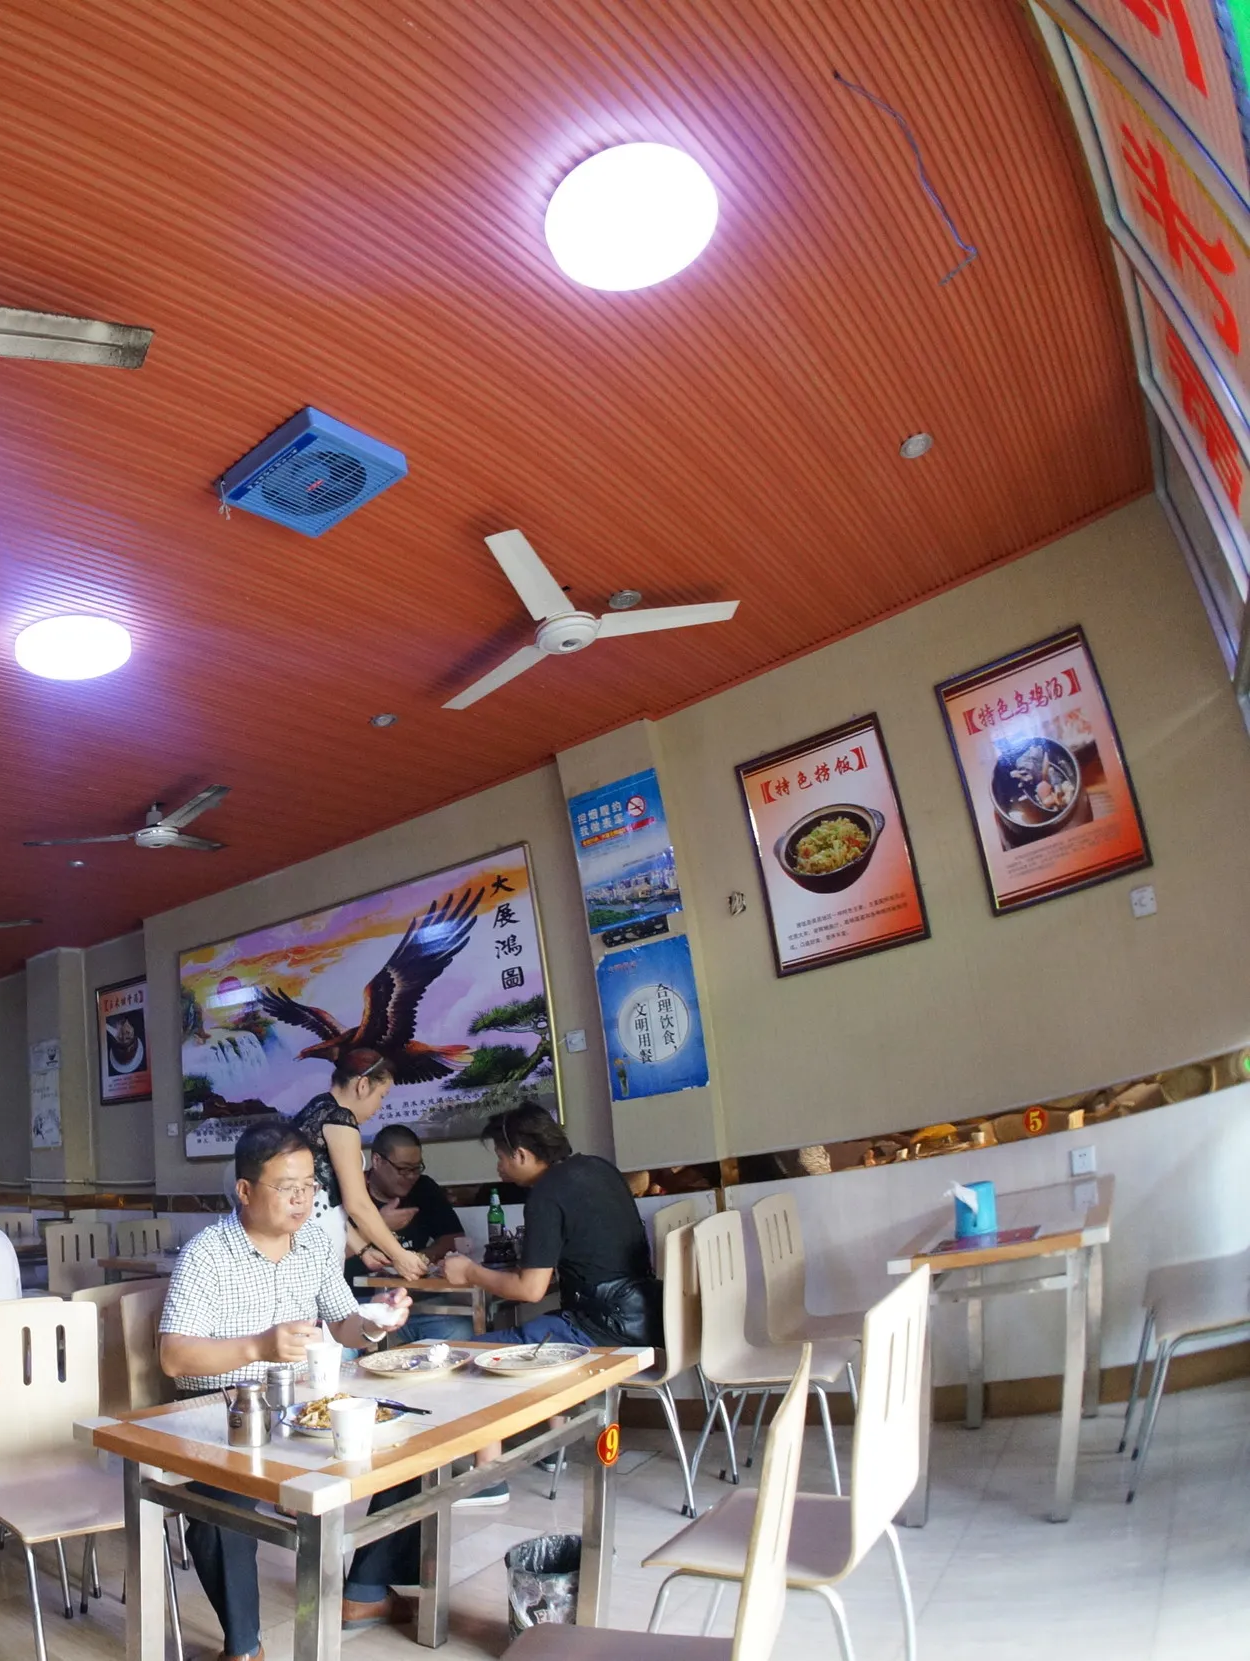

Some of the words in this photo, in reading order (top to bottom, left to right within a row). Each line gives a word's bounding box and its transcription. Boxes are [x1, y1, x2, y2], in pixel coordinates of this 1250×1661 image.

[634, 1002, 653, 1064] 文明用餐
[1028, 1111, 1042, 1131] 5
[605, 1428, 617, 1459] 9
